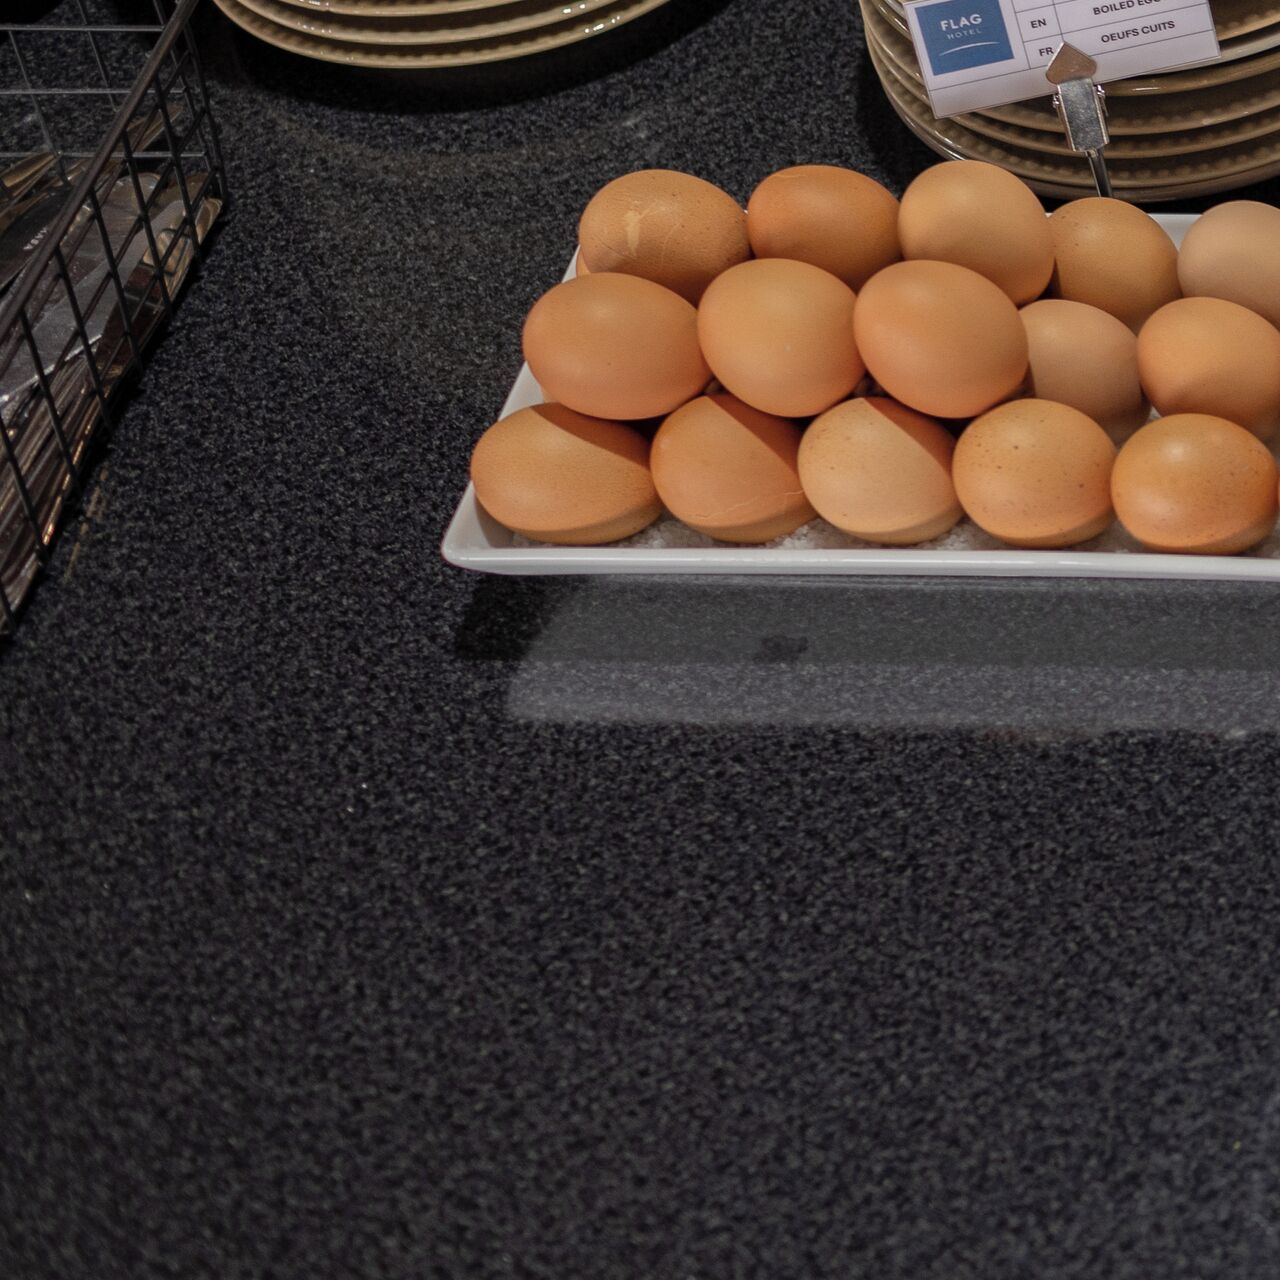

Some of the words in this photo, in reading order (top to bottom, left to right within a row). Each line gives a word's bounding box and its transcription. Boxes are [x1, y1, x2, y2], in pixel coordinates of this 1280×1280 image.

[940, 13, 982, 32] FLAG
[1030, 18, 1047, 29] EN
[946, 28, 982, 40] HOTEL
[1100, 28, 1140, 43] OEUFS
[1141, 20, 1175, 34] CUITS
[1038, 46, 1054, 57] FR
